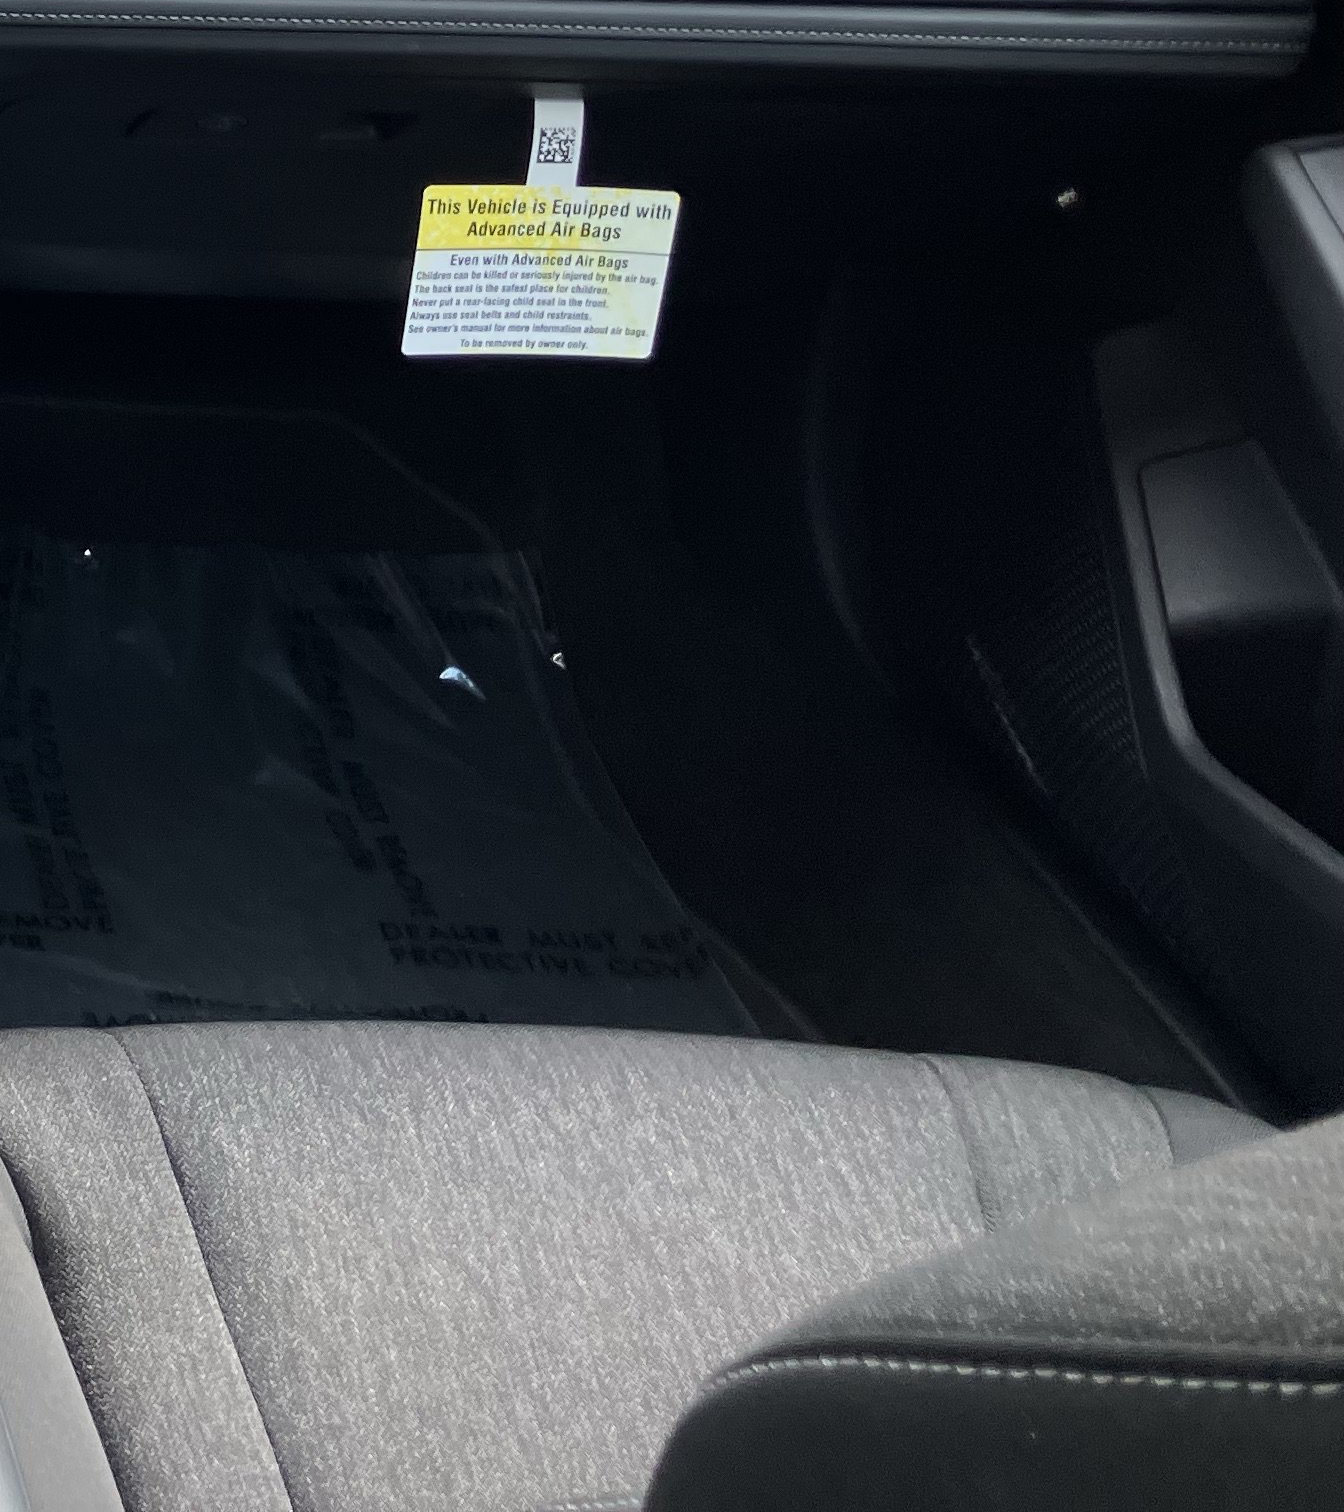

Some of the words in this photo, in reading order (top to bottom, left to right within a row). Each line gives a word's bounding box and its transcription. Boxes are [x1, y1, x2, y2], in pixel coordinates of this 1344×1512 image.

[427, 198, 462, 215] This
[467, 198, 527, 215] Vehicle
[532, 199, 547, 215] is
[552, 199, 631, 219] Equipped
[636, 203, 672, 220] with
[466, 221, 546, 237] Advanced
[550, 222, 576, 237] Air
[580, 223, 622, 242] Bags
[450, 254, 479, 266] Even
[483, 254, 508, 266] with
[512, 254, 572, 266] Advanced
[575, 255, 594, 267] Air
[598, 256, 629, 270] Bags
[416, 271, 451, 280] Children
[453, 272, 469, 280] can
[471, 271, 482, 280] be
[483, 271, 508, 280] killed
[509, 272, 518, 280] or
[520, 271, 560, 282] seriously
[562, 271, 593, 282] injured
[595, 272, 606, 283] by
[608, 273, 622, 282] the
[624, 274, 638, 283] air
[415, 284, 430, 294] The
[432, 284, 452, 293] back
[454, 284, 472, 293] seat
[475, 283, 483, 293] is
[485, 284, 499, 293] the
[501, 284, 528, 293] safest
[529, 284, 554, 294] place
[556, 284, 569, 293] for
[412, 298, 437, 307] Never
[439, 298, 454, 308] put
[512, 297, 534, 306] child
[536, 298, 555, 306] seat
[558, 298, 566, 306] in
[568, 298, 583, 307] the
[410, 311, 440, 321] Always
[442, 311, 458, 319] use
[460, 310, 479, 319] seat
[481, 310, 502, 319] belts
[504, 310, 520, 319] and
[522, 310, 544, 319] child
[408, 324, 424, 333] See
[494, 324, 505, 332] for
[583, 326, 608, 335] about
[610, 326, 622, 335] air
[460, 338, 470, 348] To
[472, 339, 482, 348] be
[485, 339, 523, 348] removed
[525, 339, 536, 349] by
[538, 340, 565, 348] owner
